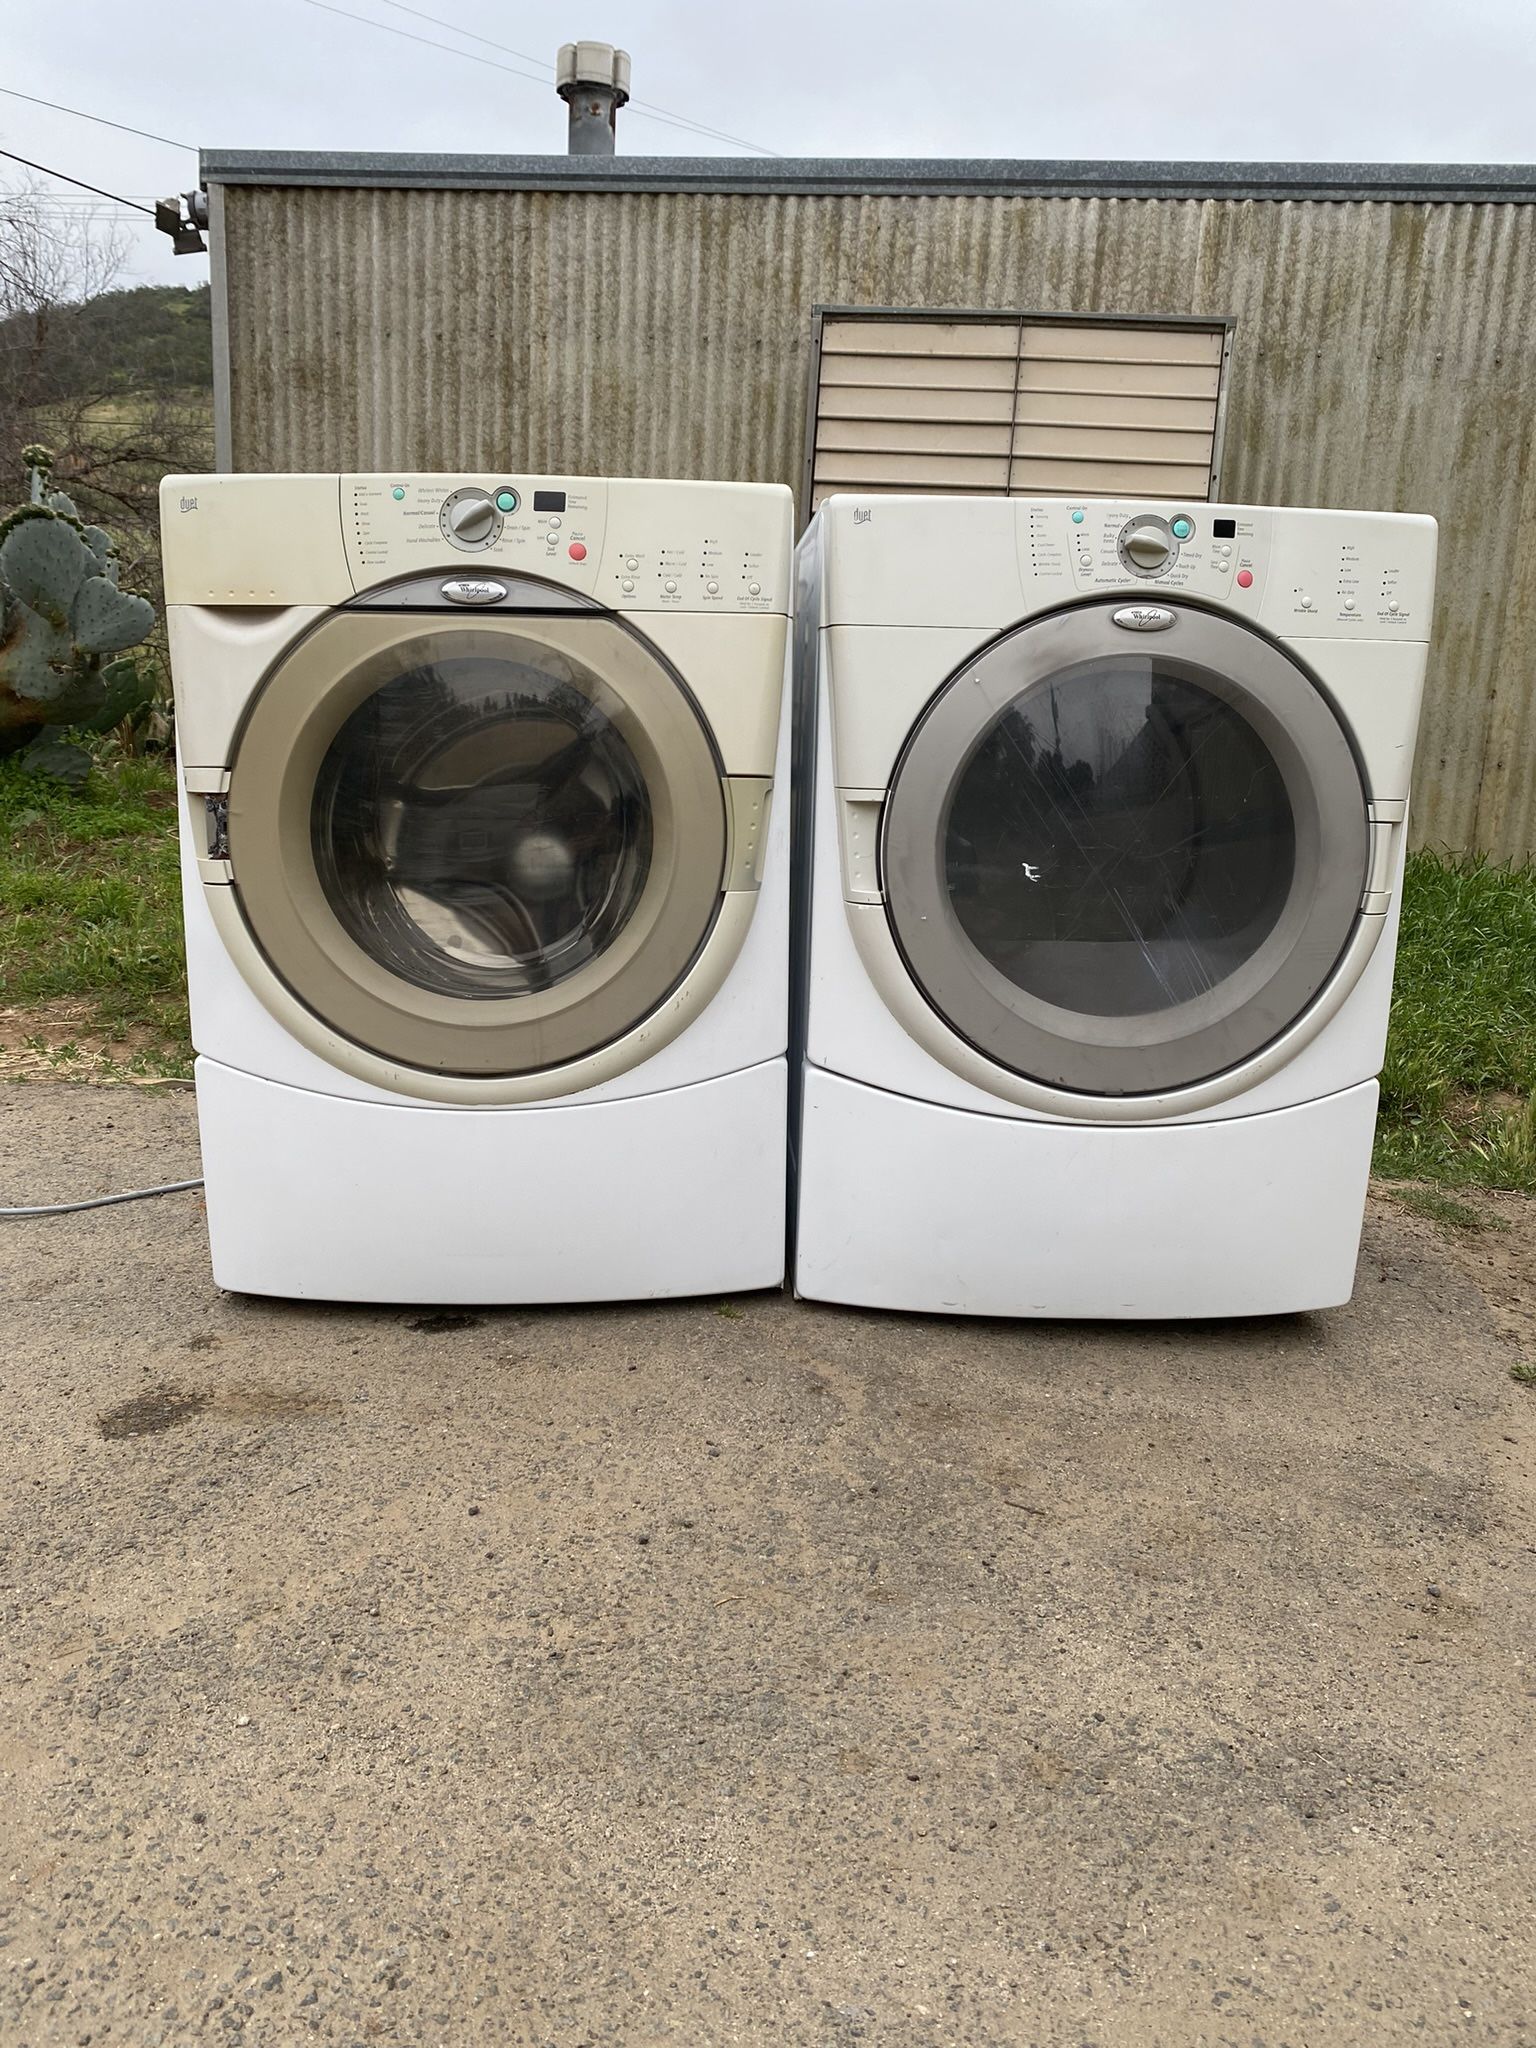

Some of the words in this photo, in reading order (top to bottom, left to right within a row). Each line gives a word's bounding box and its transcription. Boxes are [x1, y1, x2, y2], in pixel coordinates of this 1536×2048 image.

[854, 508, 871, 524] duet
[460, 586, 489, 596] Whirlpool
[1133, 612, 1161, 622] Whirlpool
